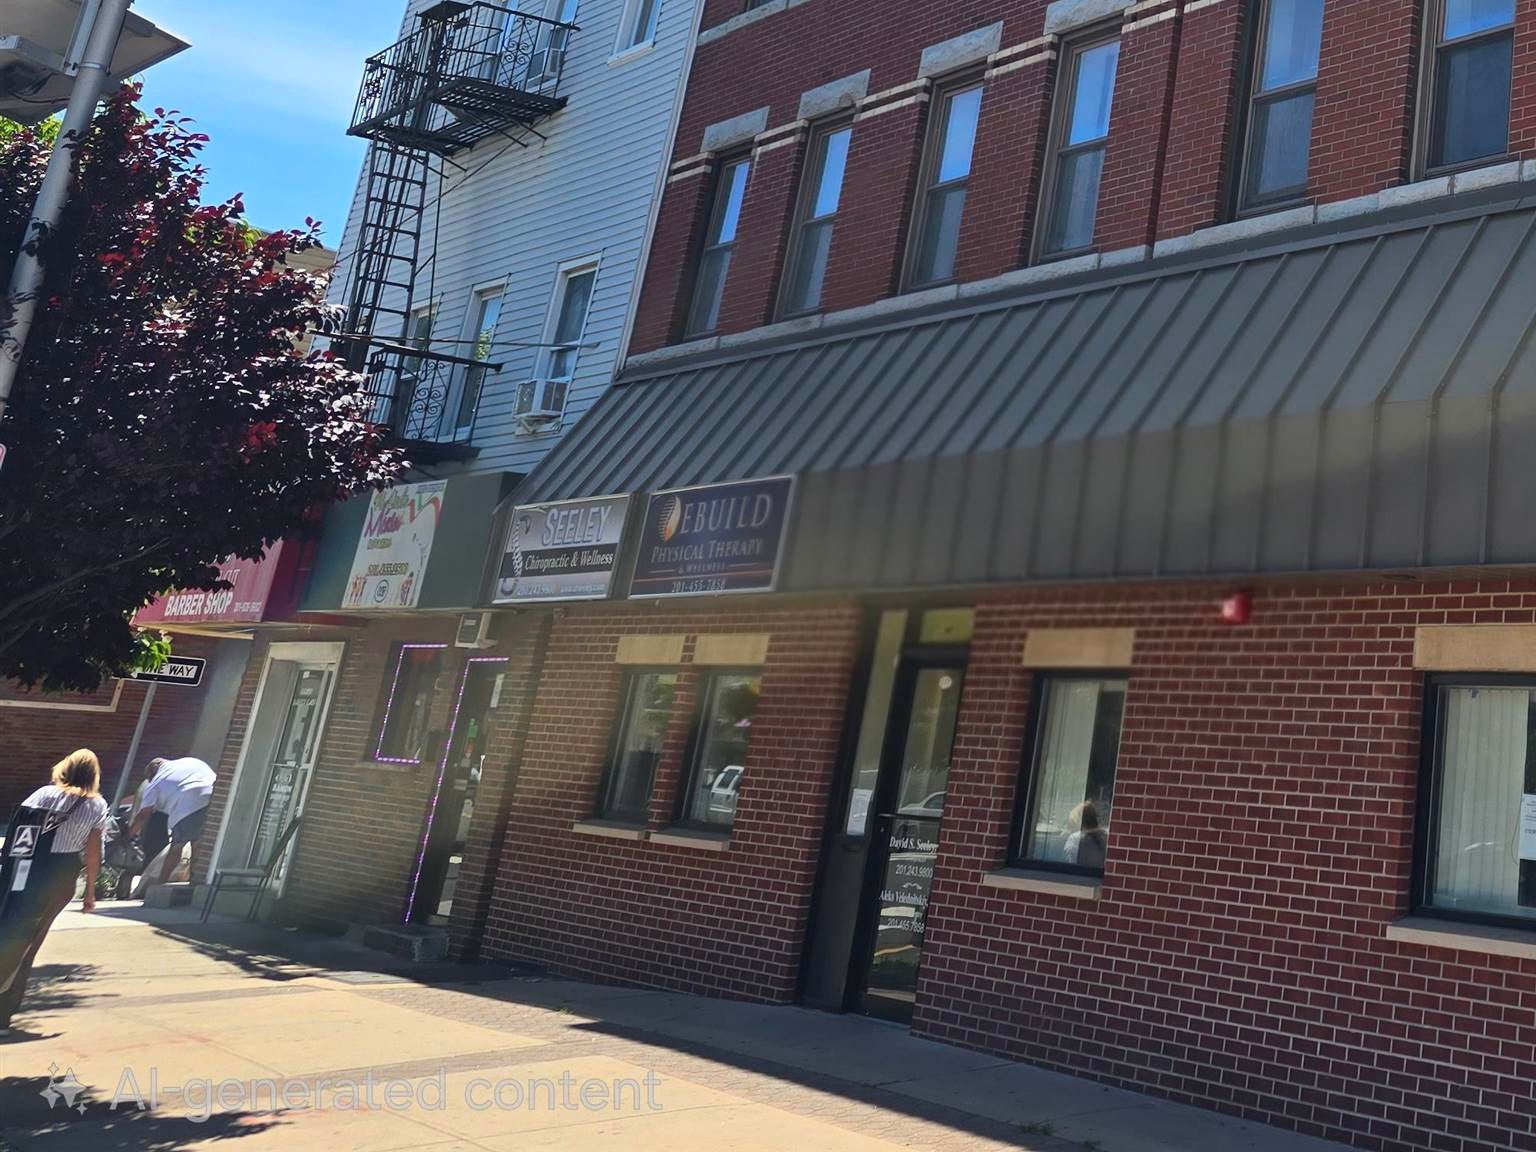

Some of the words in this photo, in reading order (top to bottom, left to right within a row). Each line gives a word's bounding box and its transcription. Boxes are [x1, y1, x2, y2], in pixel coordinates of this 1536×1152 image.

[542, 506, 611, 546] SEELEY
[525, 552, 569, 572] Chiropractic
[570, 551, 578, 567] &
[580, 550, 613, 566] Wellness
[651, 545, 704, 563] PHYSICAL
[708, 538, 763, 558] THERAPY
[165, 593, 205, 617] BARBER
[204, 592, 233, 615] SHOP
[169, 665, 193, 676] WAY
[889, 836, 909, 850] David
